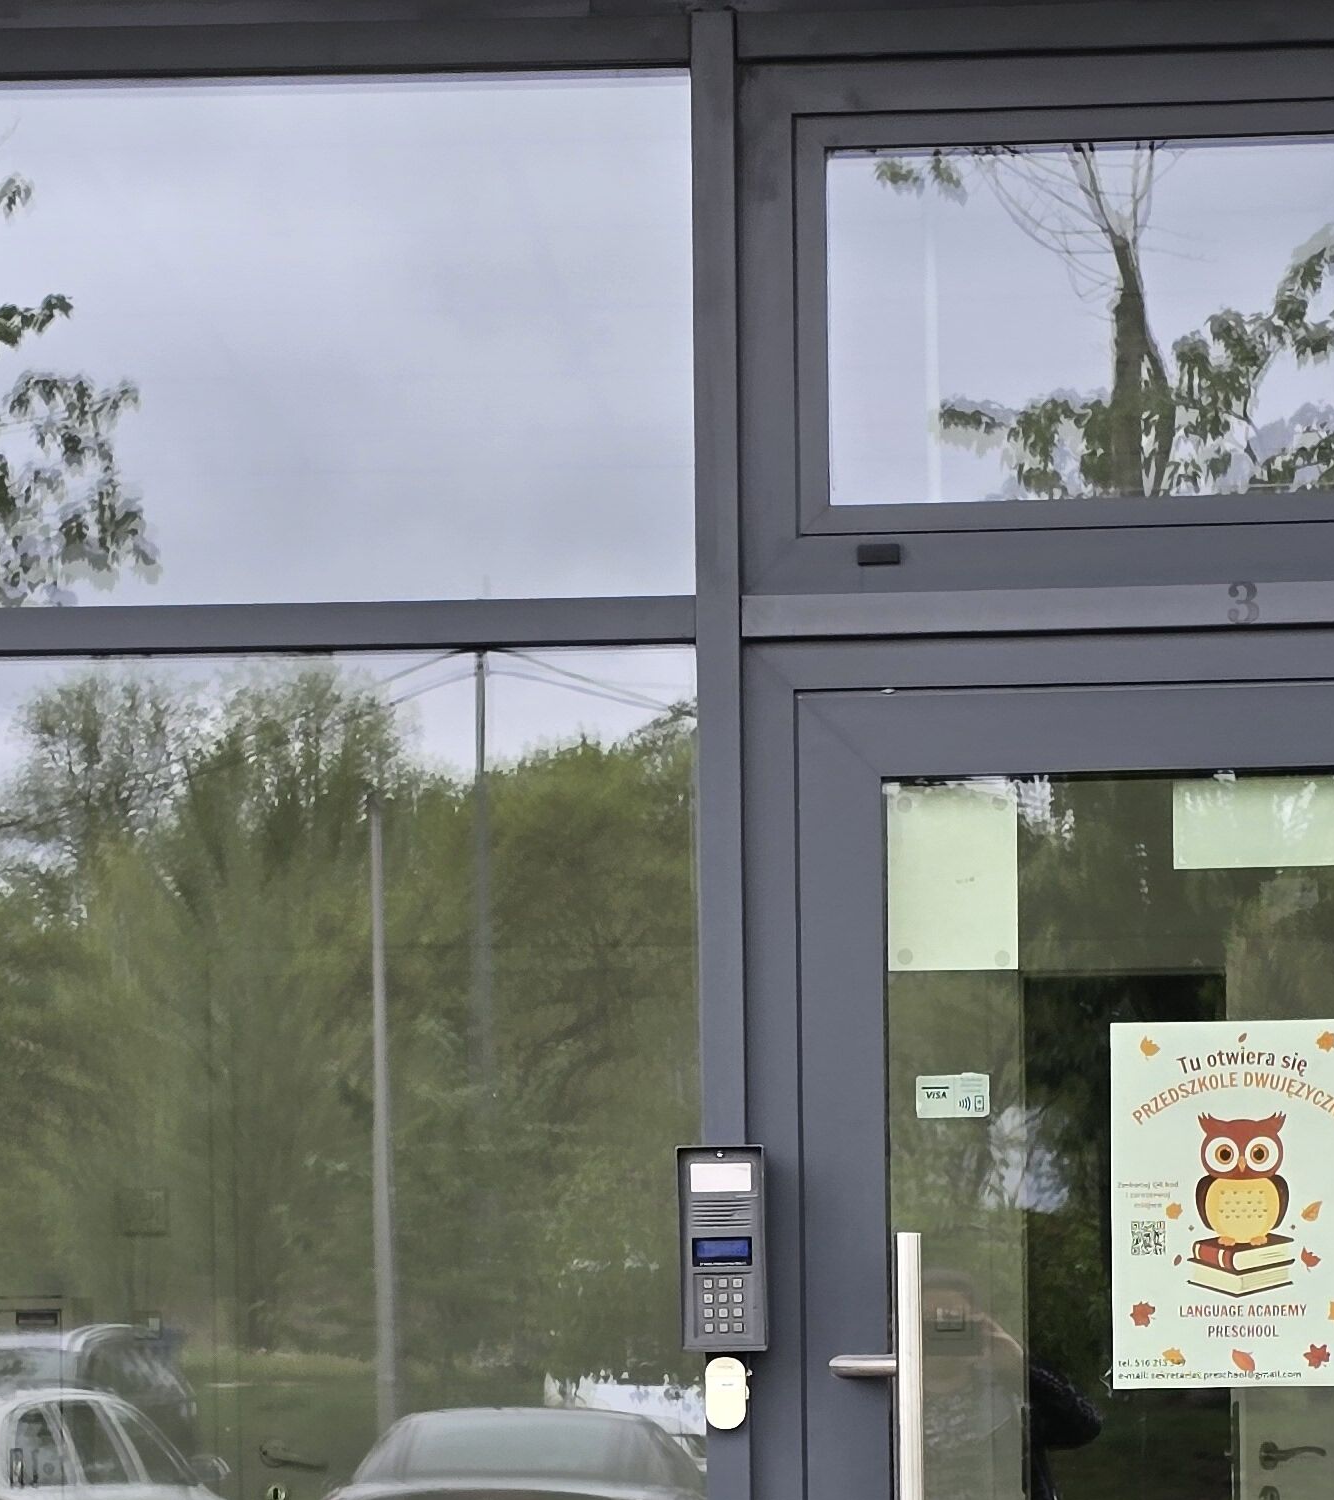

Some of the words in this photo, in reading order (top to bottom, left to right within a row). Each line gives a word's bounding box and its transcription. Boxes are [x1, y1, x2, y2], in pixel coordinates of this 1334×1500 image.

[1228, 581, 1260, 624] 3
[1177, 1056, 1202, 1074] Tu
[1208, 1046, 1275, 1067] otwiera
[1281, 1052, 1308, 1076] się
[926, 1091, 947, 1099] VISA
[1132, 1072, 1238, 1125] PRZEDSZKOLE
[1179, 1305, 1244, 1317] LANGUAGE
[1248, 1304, 1307, 1316] ACADEMY
[1208, 1325, 1279, 1337] PRESCHOOL
